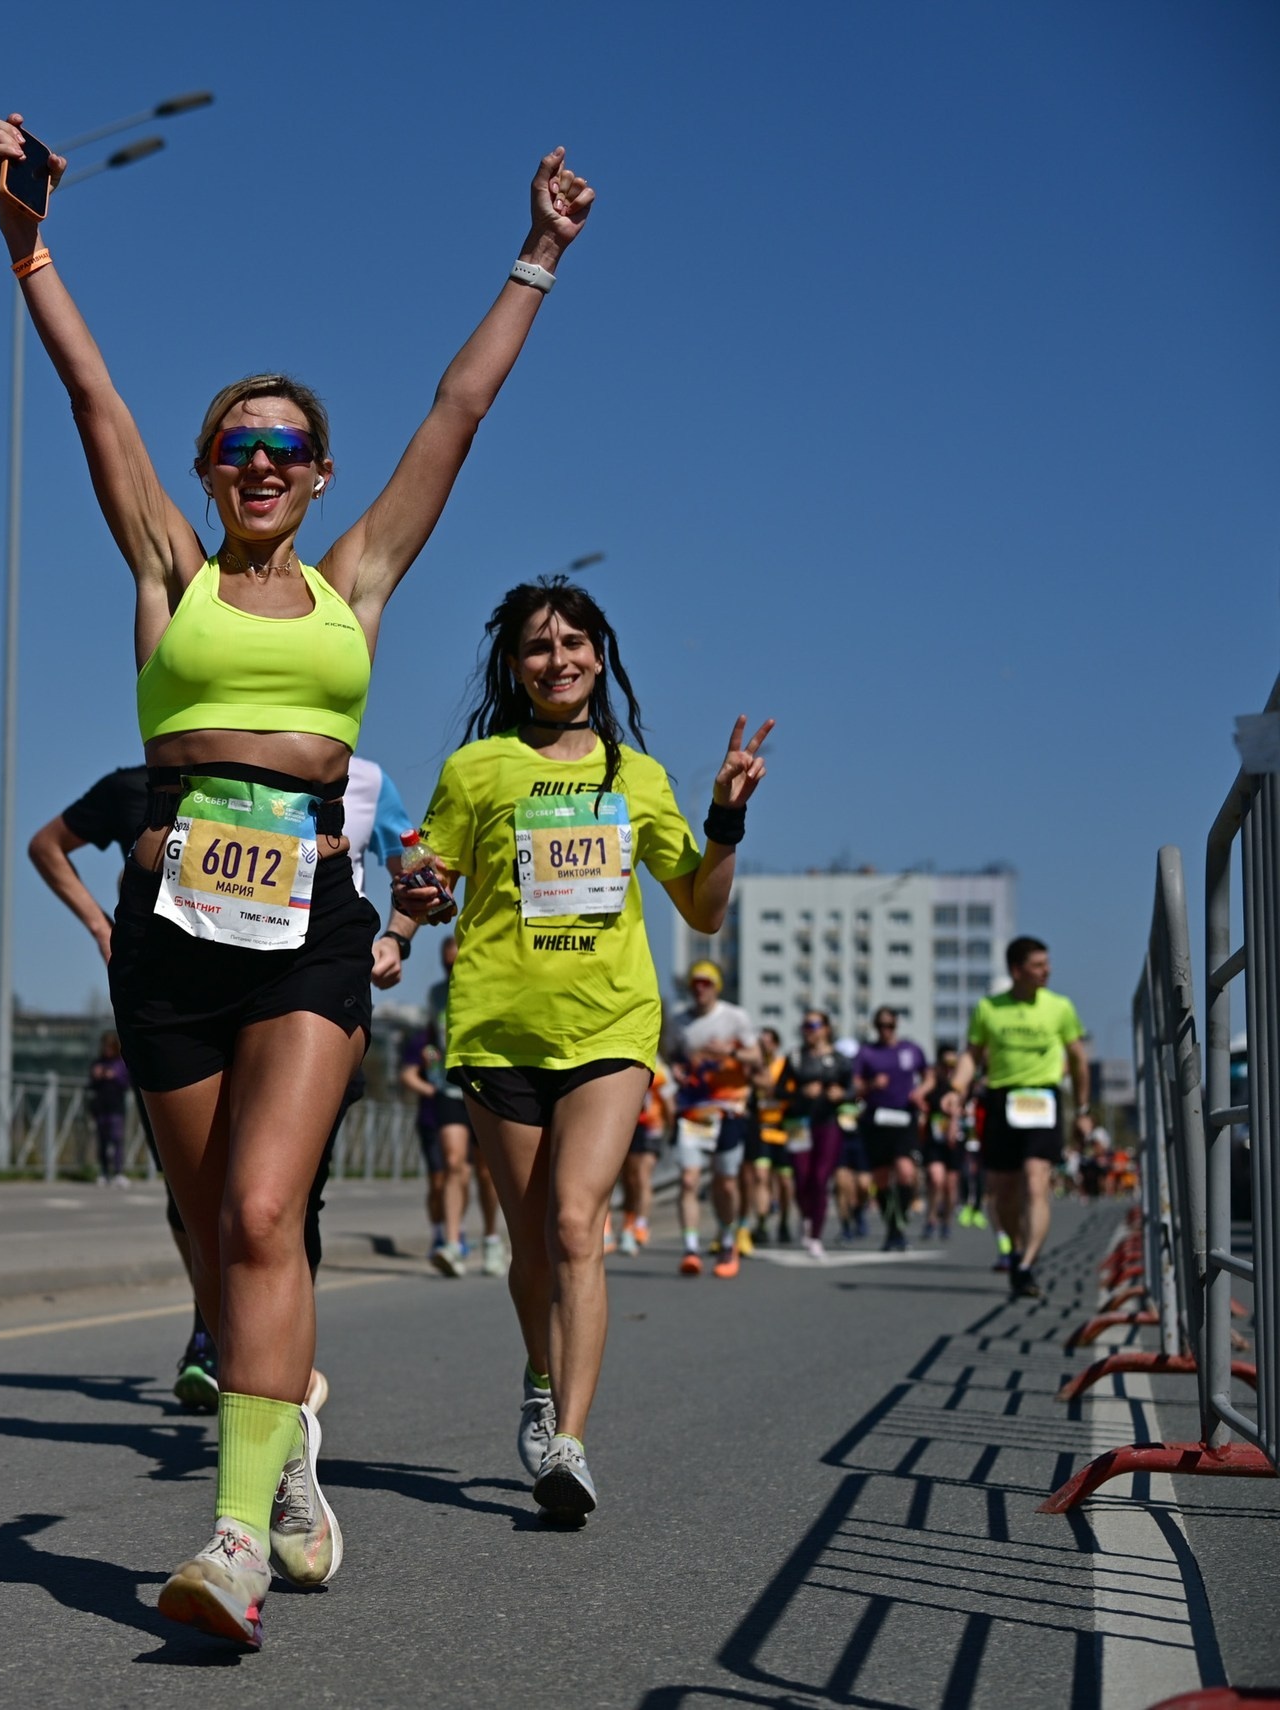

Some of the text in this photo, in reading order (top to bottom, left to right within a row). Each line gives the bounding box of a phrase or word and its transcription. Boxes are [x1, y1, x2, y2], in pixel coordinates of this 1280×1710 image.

[205, 796, 228, 806] СБЕР
[166, 839, 183, 860] G
[518, 849, 532, 865] D
[549, 837, 606, 868] 8471
[201, 838, 282, 887] 6012
[557, 867, 602, 879] ВИКТОРИЯ
[215, 880, 255, 898] МАРИЯ
[543, 888, 574, 897] МАГНИТ
[184, 899, 222, 914] МАГНИТ
